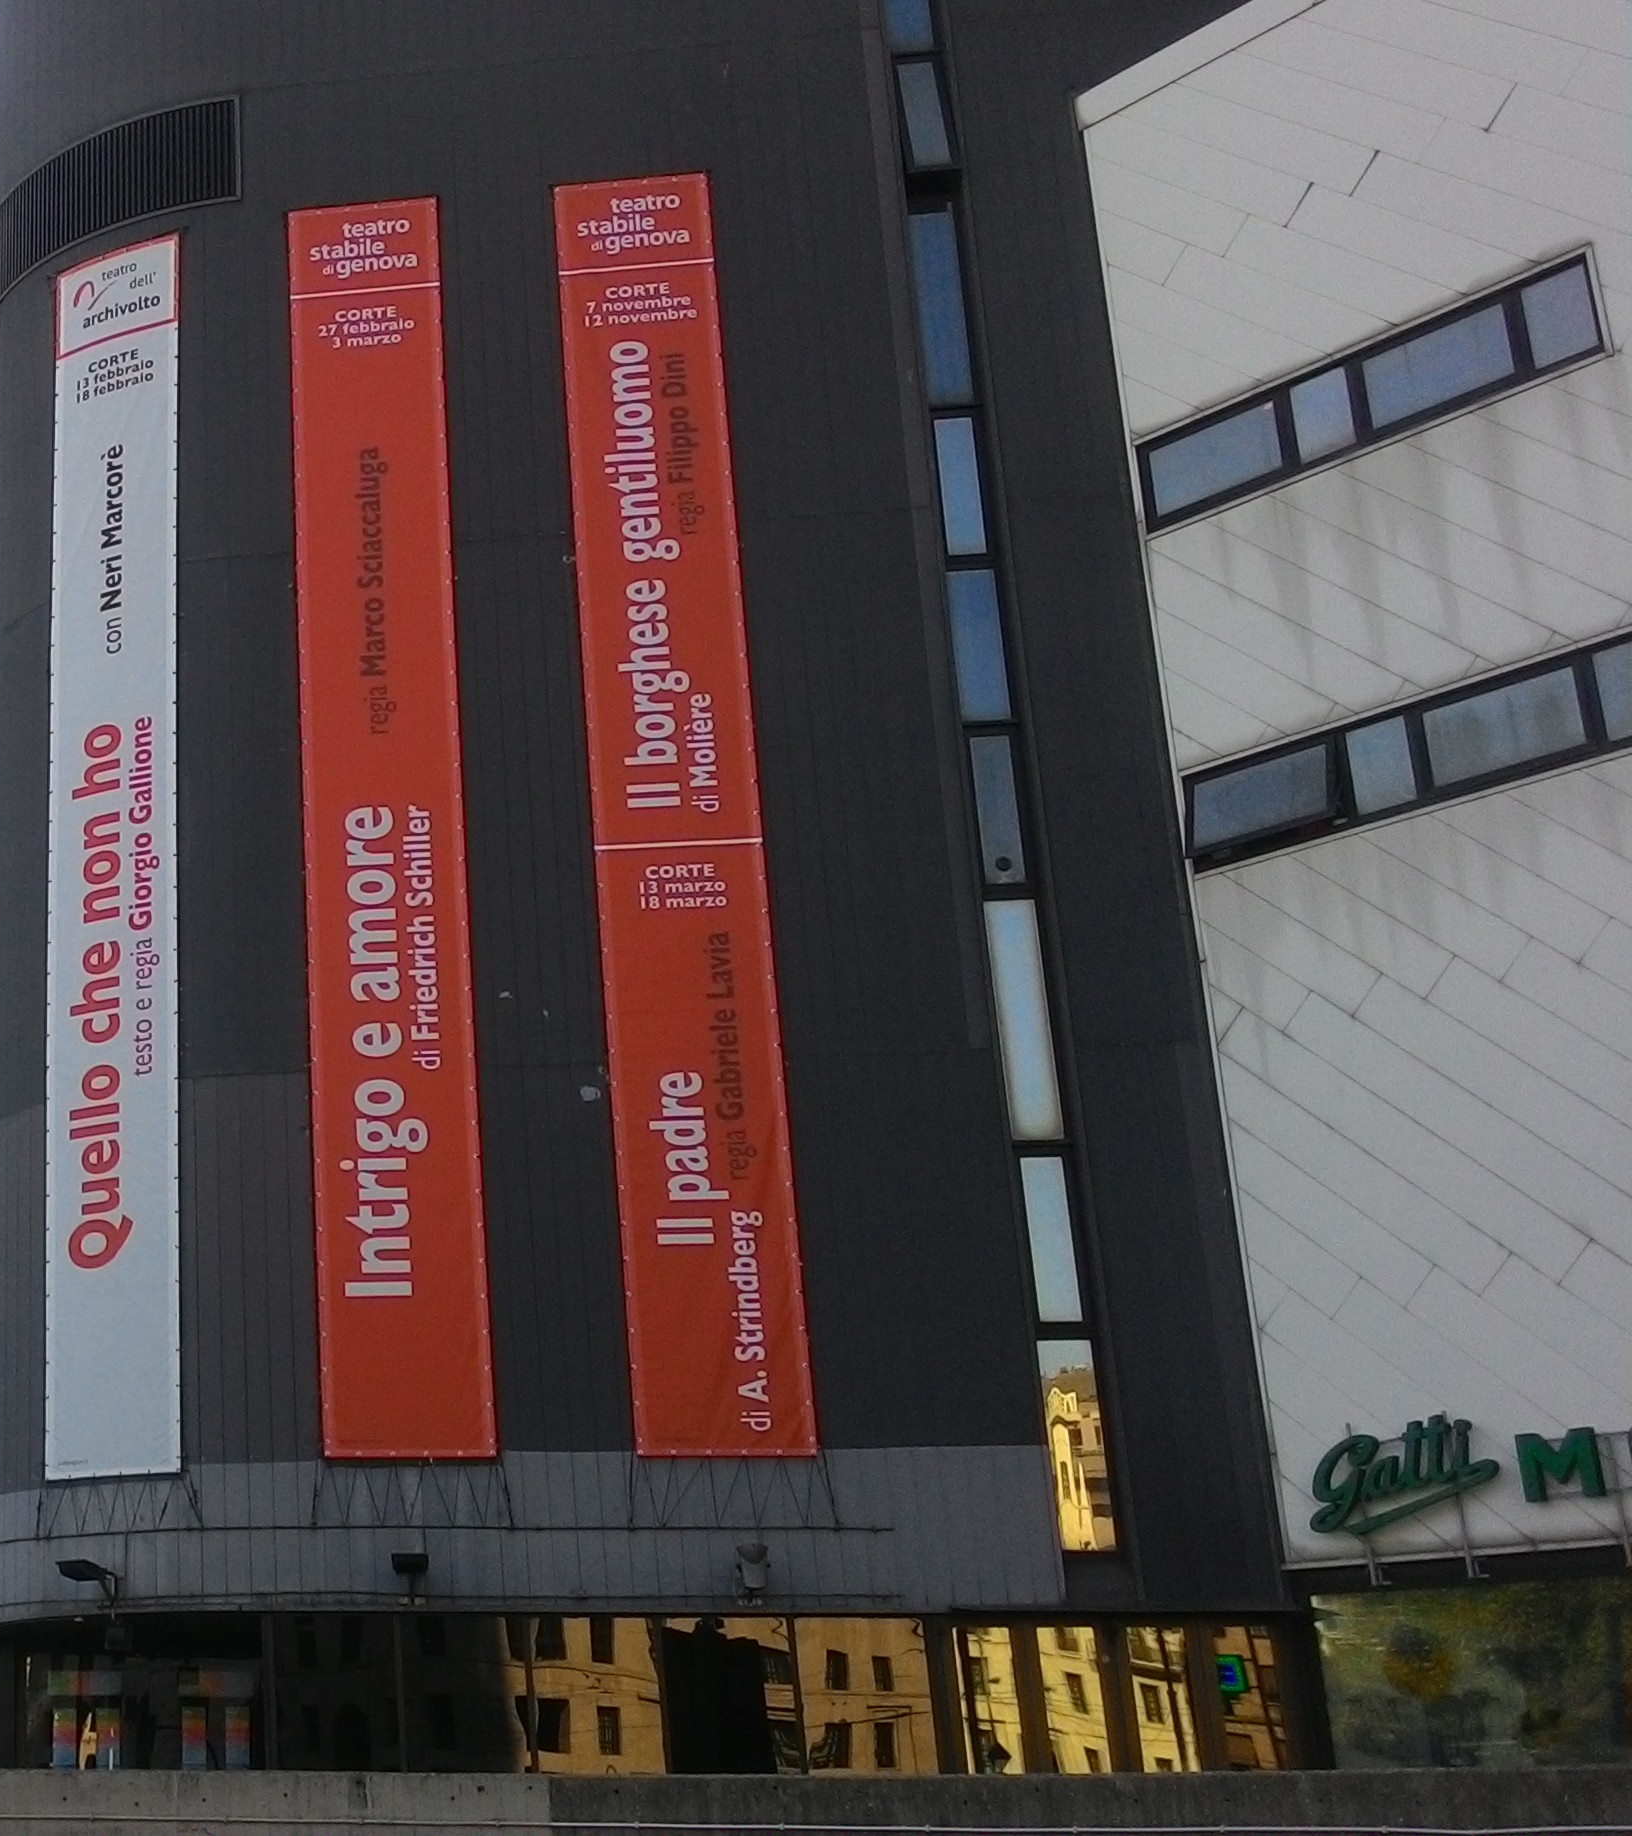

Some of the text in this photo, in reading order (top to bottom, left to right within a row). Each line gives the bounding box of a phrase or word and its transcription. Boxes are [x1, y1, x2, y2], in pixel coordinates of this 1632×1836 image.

[610, 194, 681, 214] teatro
[342, 218, 411, 239] teatro
[576, 213, 656, 237] stabile
[309, 238, 386, 262] stabile
[590, 229, 691, 255] di genova
[101, 262, 137, 281] teatro
[321, 253, 418, 279] di genova
[604, 282, 671, 299] CORTE
[82, 293, 161, 329] archivolto
[334, 305, 398, 323] CORTE
[584, 307, 698, 328] 12 novembre
[586, 295, 692, 314] 7 novembre
[318, 318, 416, 338] 27 febbraio
[332, 332, 402, 349] 3 marzo
[88, 349, 140, 373] CORTE
[76, 359, 154, 391] 13 febbraio
[76, 372, 154, 404] 18 febbraio
[659, 353, 705, 535] regia Filippo Dini
[99, 444, 124, 655] con Neri Marcorè
[603, 341, 691, 809] Il borghese gentiluomo
[355, 447, 397, 735] regia Marco Sciaccaluga
[683, 693, 720, 813] di Molière
[644, 863, 716, 879] CORTE
[128, 716, 160, 1077] testo e regia Giorgio Gallione
[639, 880, 727, 894] 13 marzo
[639, 895, 728, 910] 18 marzo
[402, 804, 441, 1070] di Friedrich Schiller
[68, 724, 134, 1270] Quello che non ho
[338, 806, 429, 1298] Intrigo e amore
[702, 931, 757, 1181] regia Gabriele Lavia
[648, 1071, 730, 1245] Il padre
[728, 1210, 772, 1431] di A. Strindberg
[1514, 1427, 1632, 1502] M
